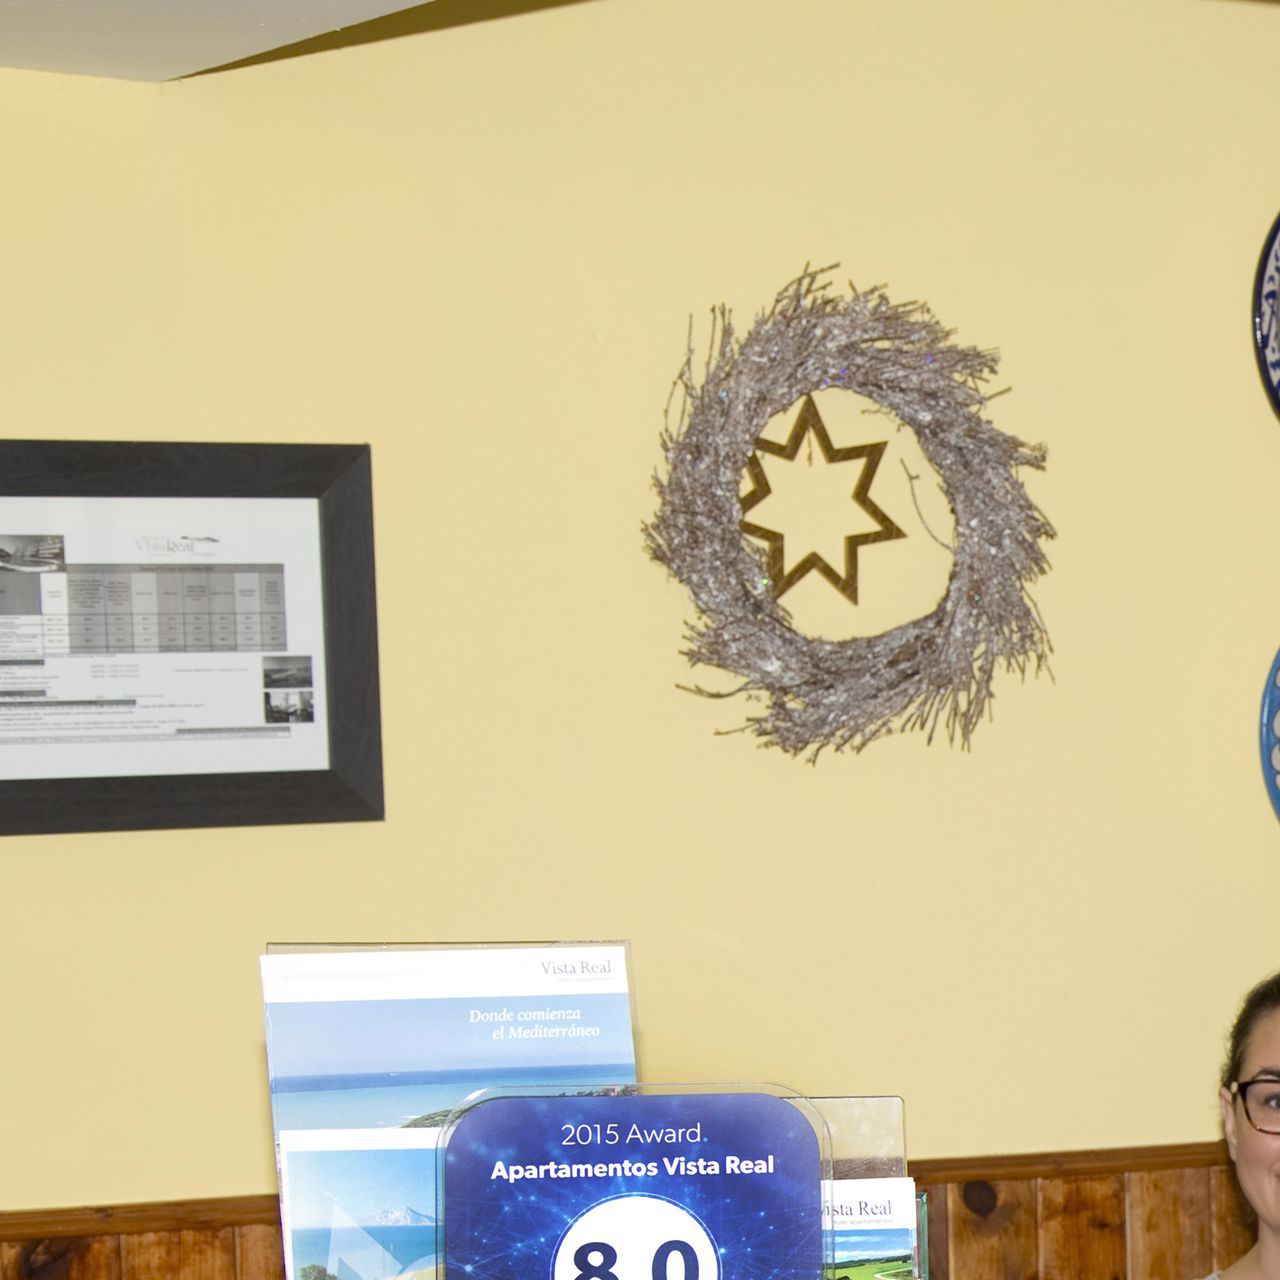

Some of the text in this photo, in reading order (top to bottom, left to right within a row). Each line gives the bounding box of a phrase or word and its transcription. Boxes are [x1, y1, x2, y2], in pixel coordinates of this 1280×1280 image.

[540, 959, 612, 976] Vista Real
[469, 1008, 581, 1023] Donde comienza
[492, 1024, 600, 1040] el Mediterráneo
[561, 1123, 619, 1145] 2015
[490, 1155, 774, 1184] Apartamentos Vista Real
[821, 1199, 892, 1217] ista Real
